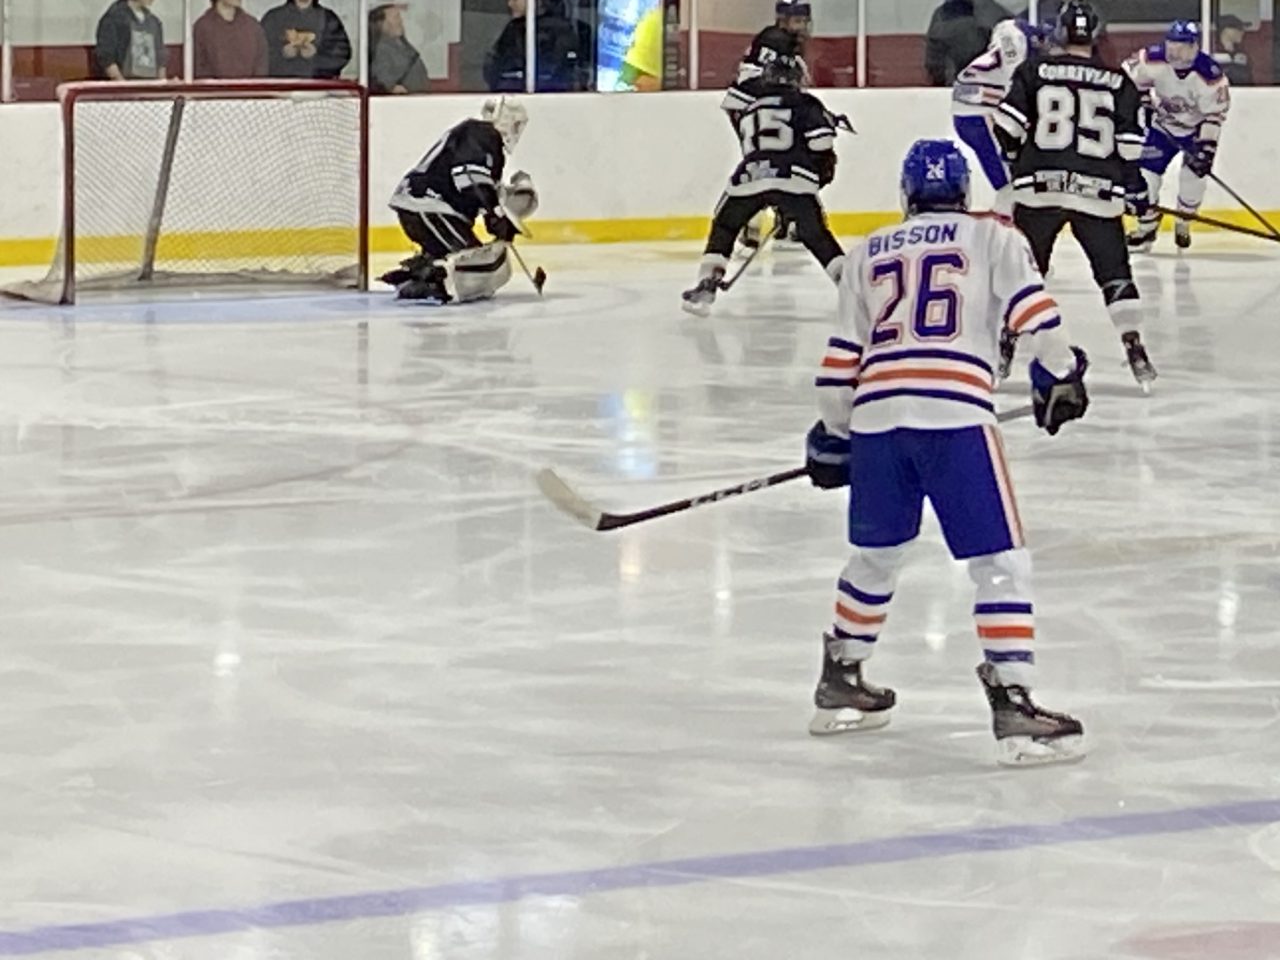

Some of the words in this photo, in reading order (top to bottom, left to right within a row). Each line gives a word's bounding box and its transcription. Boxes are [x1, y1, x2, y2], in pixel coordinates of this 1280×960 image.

[739, 108, 794, 157] 15
[1034, 84, 1115, 159] 85
[868, 223, 958, 258] BISSON
[869, 247, 969, 348] 26
